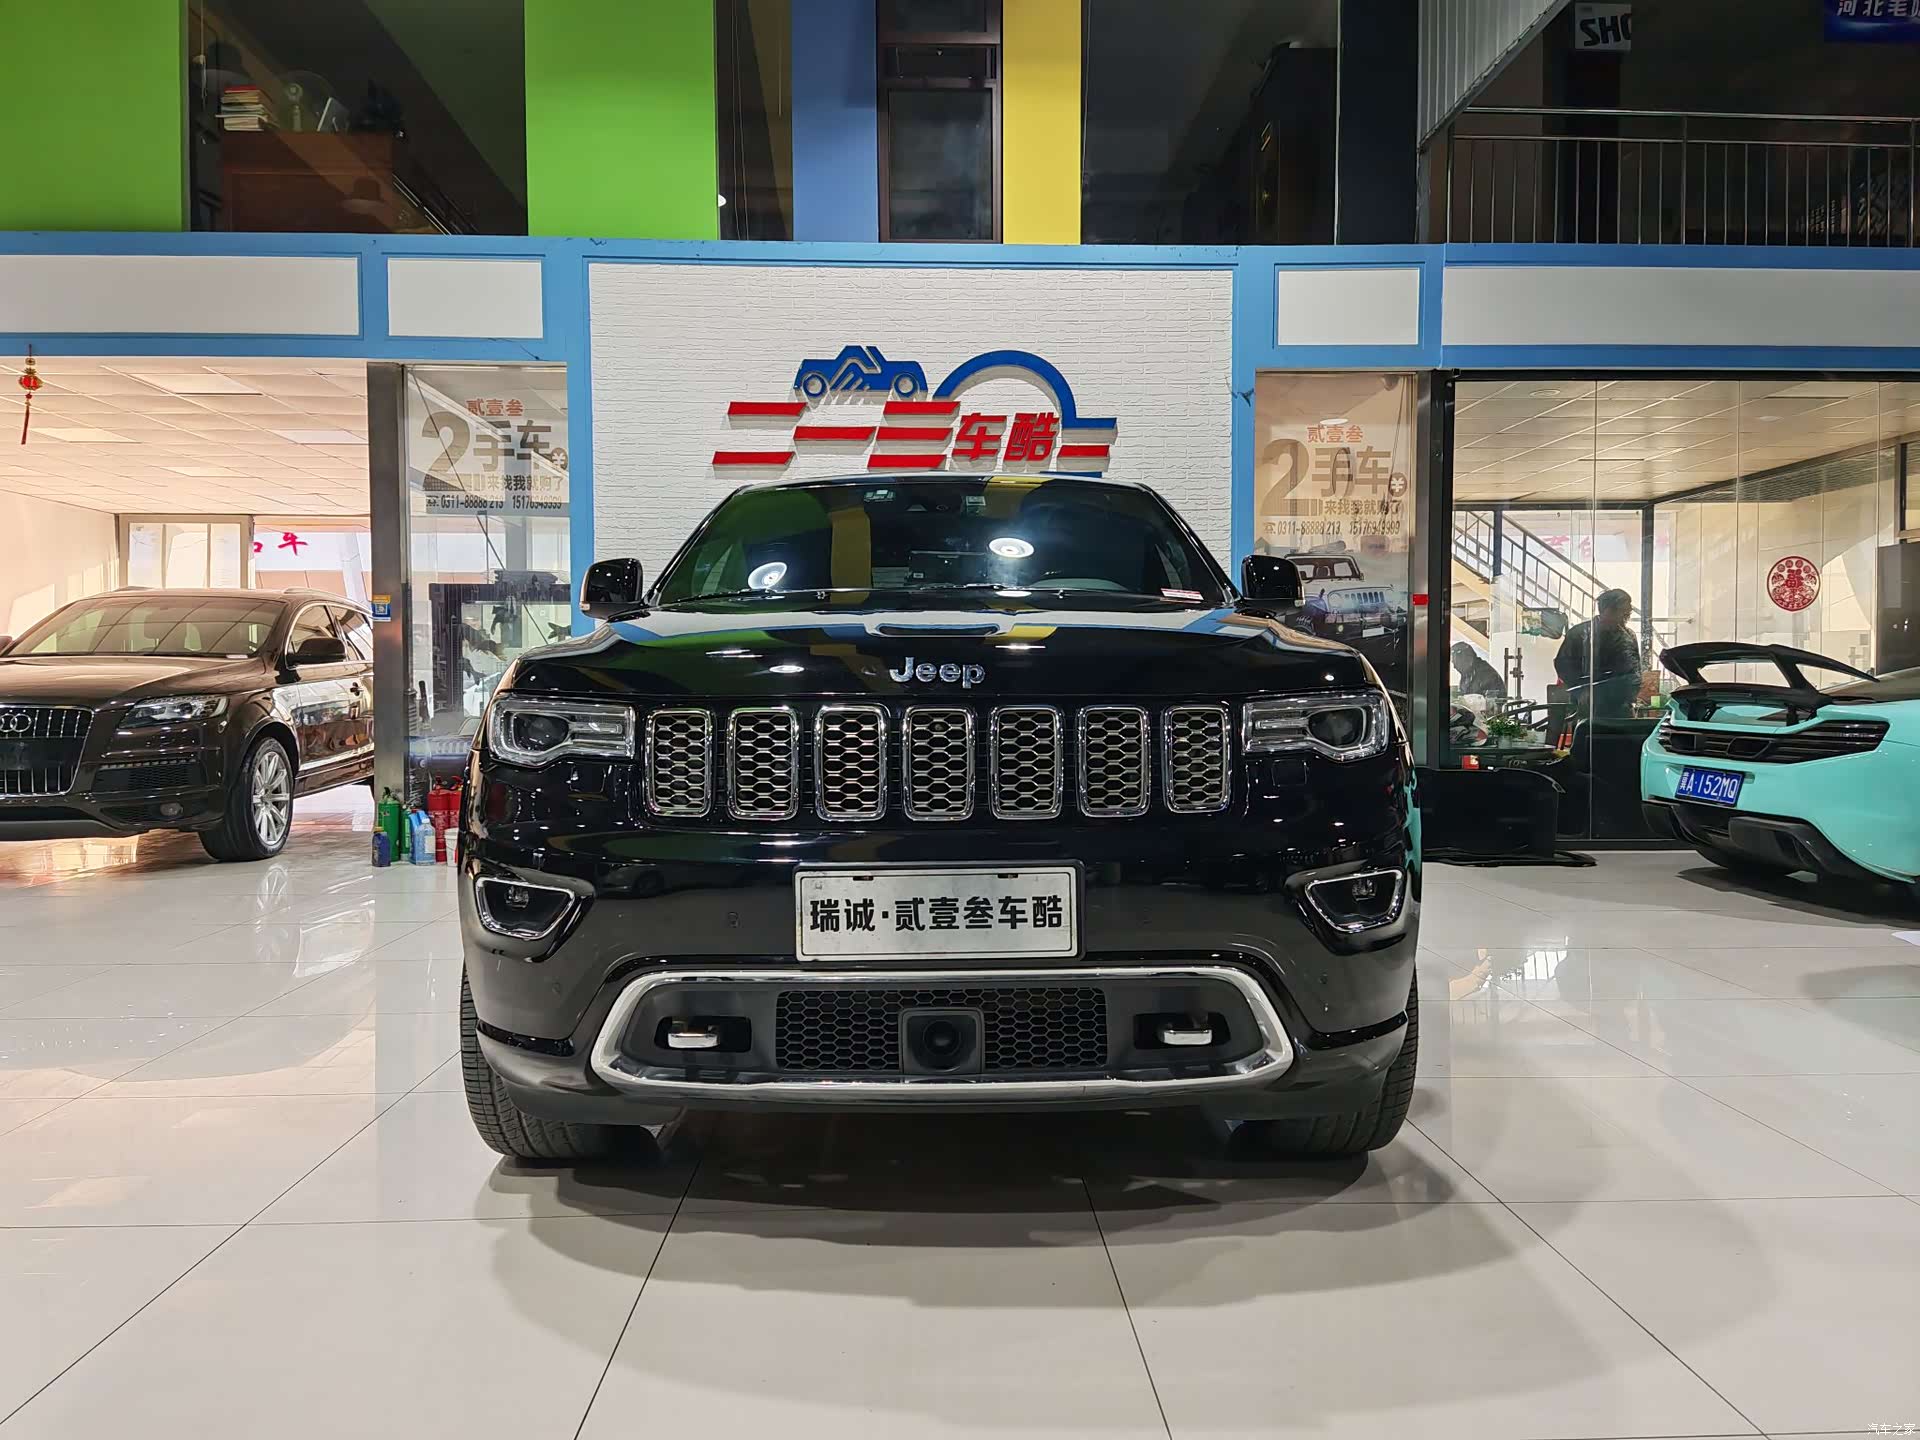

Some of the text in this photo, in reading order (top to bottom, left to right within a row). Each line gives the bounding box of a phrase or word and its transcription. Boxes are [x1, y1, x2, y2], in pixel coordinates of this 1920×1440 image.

[1307, 425, 1363, 443] 贰壹叁
[889, 656, 985, 689] Jeep
